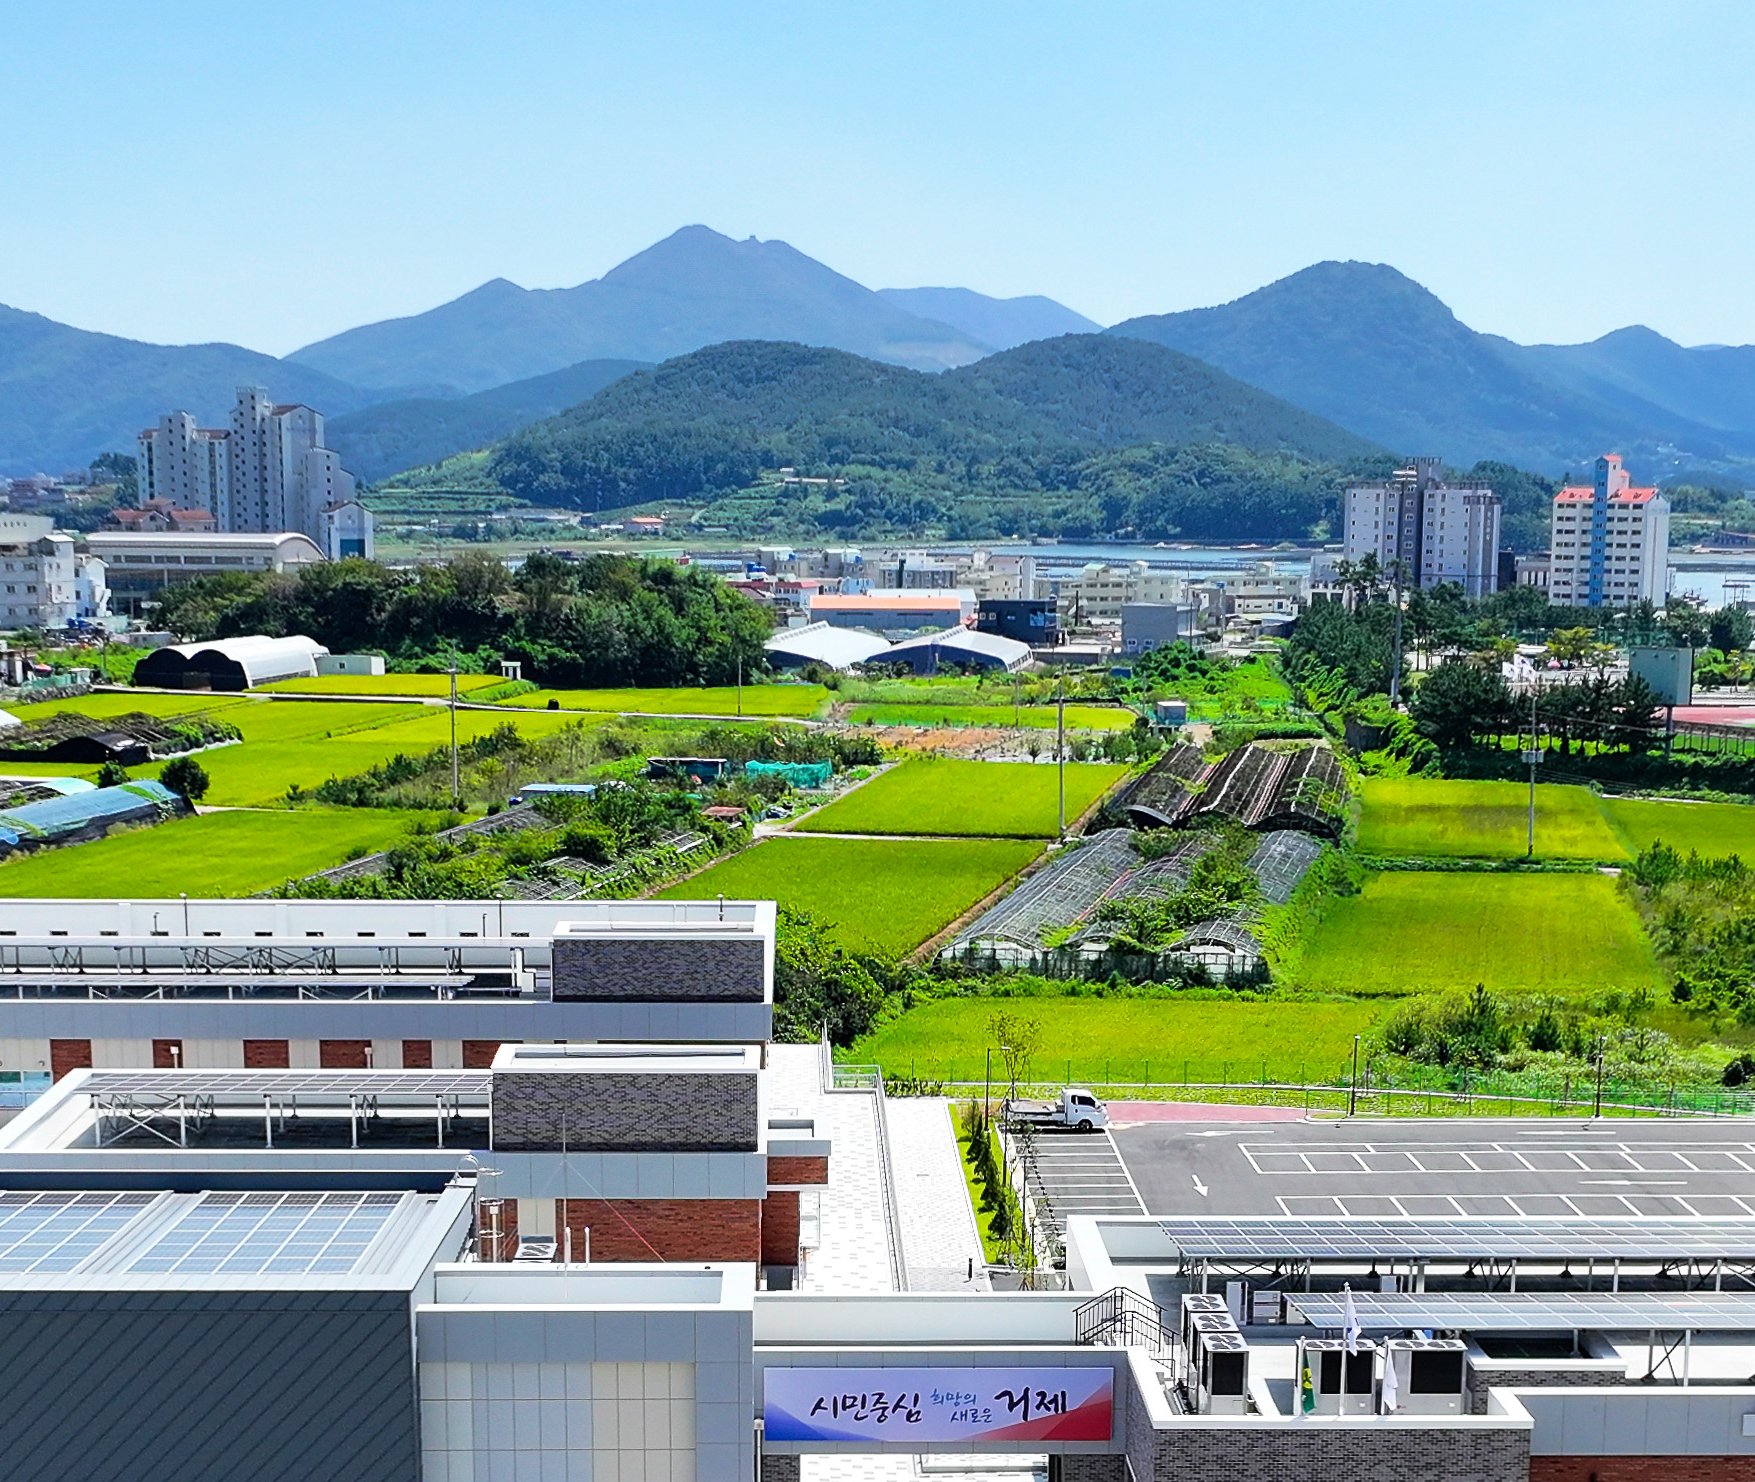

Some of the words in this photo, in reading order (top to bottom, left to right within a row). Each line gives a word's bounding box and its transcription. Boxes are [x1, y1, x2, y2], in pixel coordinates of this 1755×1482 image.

[809, 1391, 923, 1424] 시민중심
[930, 1388, 977, 1406] 희망의
[994, 1386, 1068, 1423] 거제
[950, 1408, 993, 1424] 새로운
